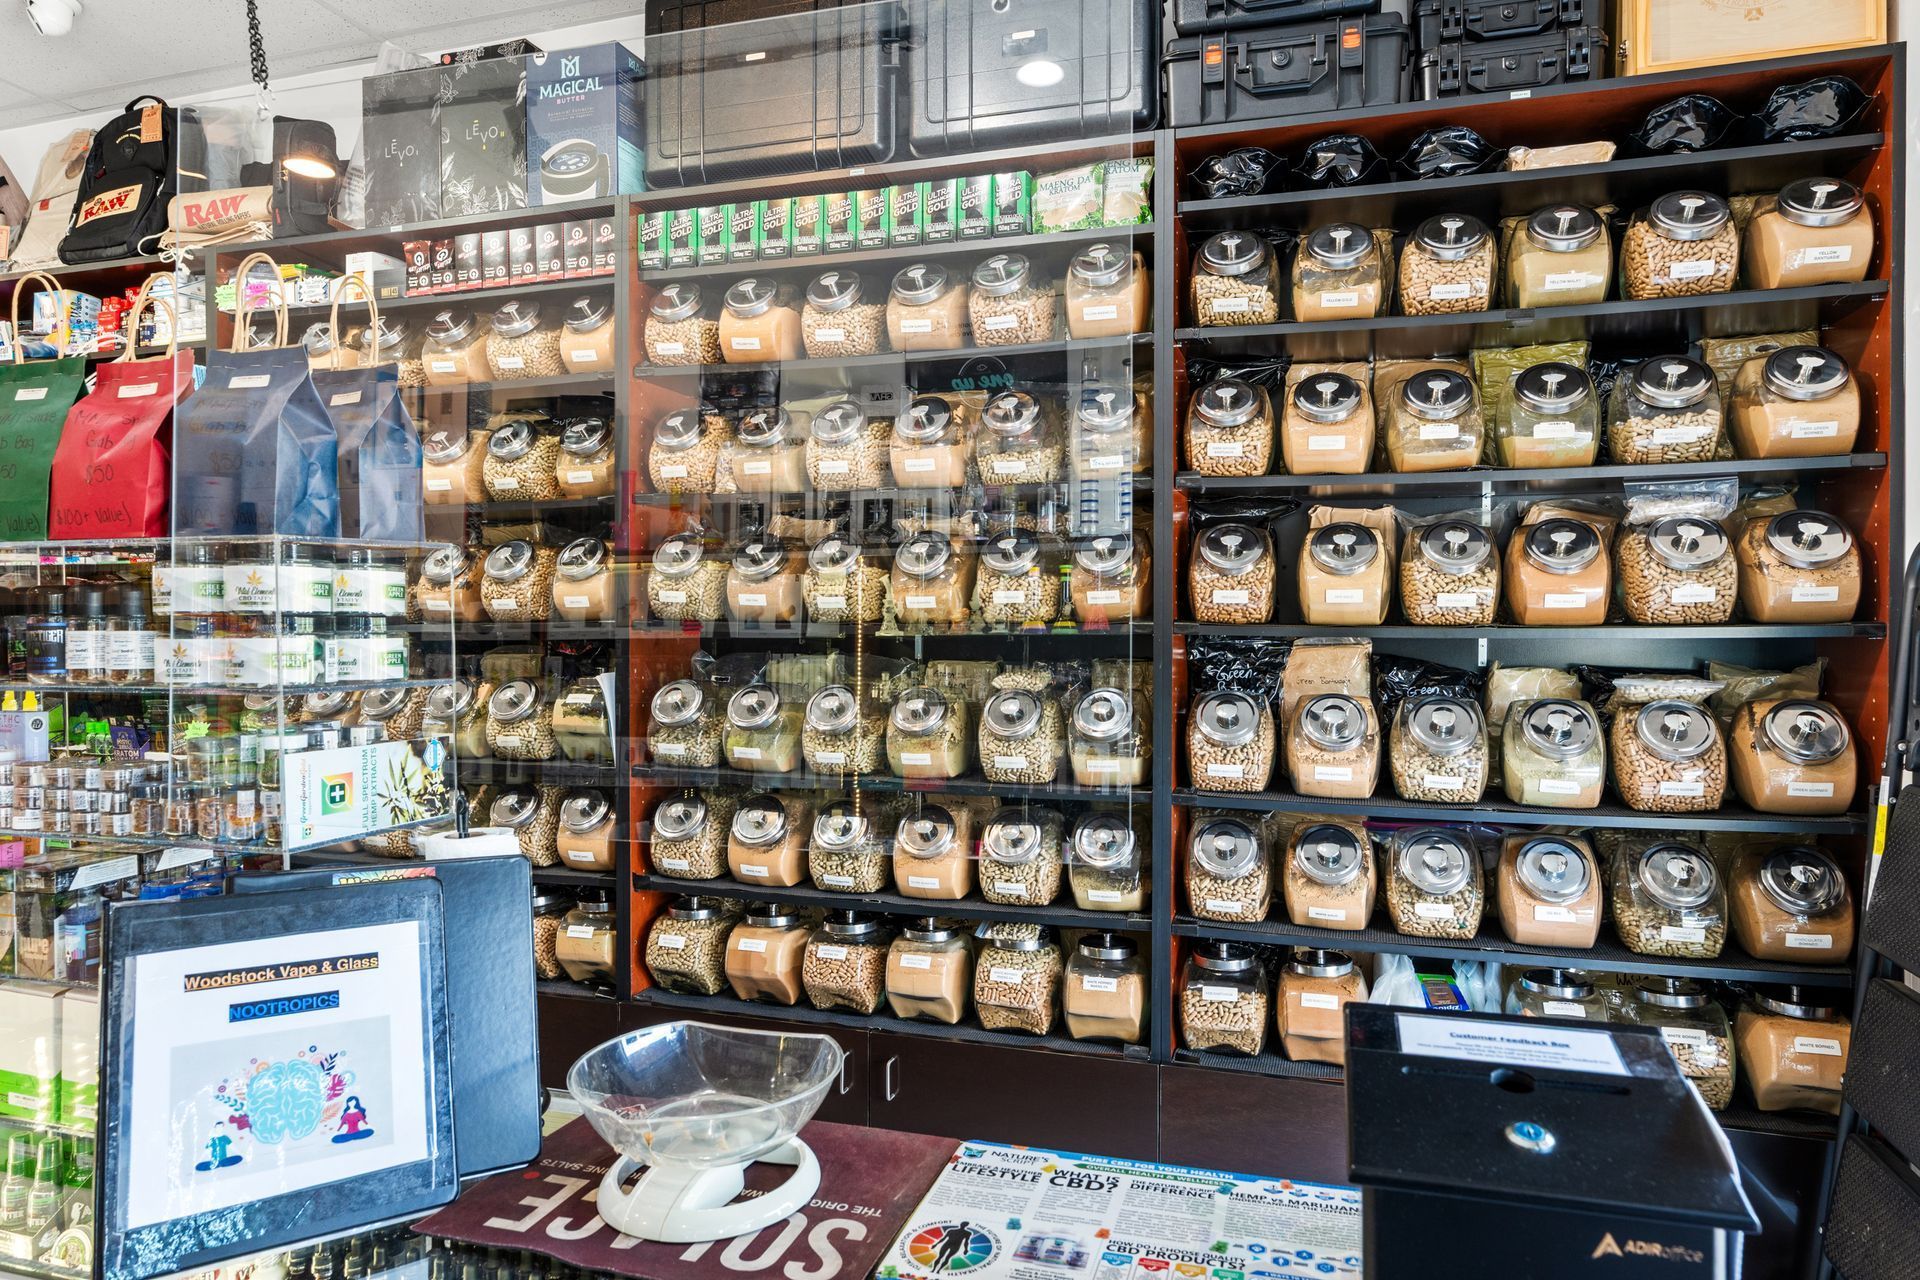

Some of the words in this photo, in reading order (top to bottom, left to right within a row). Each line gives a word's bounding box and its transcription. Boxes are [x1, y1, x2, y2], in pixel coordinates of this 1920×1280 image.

[539, 76, 604, 100] MAGICAL
[556, 94, 586, 105] BUTTER
[1136, 158, 1152, 166] DA
[1040, 178, 1074, 192] MAENG
[1077, 175, 1091, 185] DA
[1049, 184, 1080, 196] KRATOM
[860, 195, 884, 209] ULTRA
[894, 190, 918, 205] ULTRA
[83, 192, 132, 221] RAW
[184, 194, 249, 227] RAW
[763, 205, 786, 219] ULTRA
[796, 201, 818, 215] ULTRA
[828, 199, 850, 213] ULTRA
[894, 202, 918, 217] GOLD
[234, 212, 251, 222] PAPERS
[670, 214, 692, 227] ULTRA
[701, 211, 723, 226] ULTRA
[732, 208, 754, 222] ULTRA
[796, 213, 819, 228] GOLD
[828, 210, 851, 224] GOLD
[860, 207, 885, 222] GOLD
[641, 216, 662, 230] ULTRA
[701, 223, 723, 238] GOLD
[732, 219, 755, 234] GOLD
[764, 216, 787, 231] GOLD
[641, 228, 663, 243] GOLD
[670, 226, 692, 240] GOLD
[85, 465, 114, 485] $50
[1407, 686, 1440, 697] Green
[184, 966, 275, 992] Woodstock
[280, 961, 316, 980] Vape
[322, 960, 332, 973] &
[336, 953, 378, 970] Glass
[229, 992, 340, 1020] NOOTROPICS
[1450, 1032, 1497, 1042] Customer
[1500, 1036, 1546, 1047] Feedback
[1550, 1040, 1570, 1048] Box
[992, 1150, 1050, 1163] NATURE'S
[1002, 1158, 1035, 1166] SCRIPT
[540, 1158, 584, 1171] SALTS
[1081, 1156, 1108, 1165] PURE
[1111, 1160, 1132, 1168] CBD
[1135, 1163, 1156, 1171] FOR
[1159, 1166, 1187, 1174] YOUR
[1191, 1169, 1234, 1180] HEALTH
[952, 1164, 1040, 1183] LIFESTYLE
[1054, 1169, 1102, 1180] WHAT
[1086, 1164, 1125, 1174] OVERALL
[1128, 1169, 1163, 1178] HEALTH
[1177, 1176, 1225, 1186] WELLNESS
[1049, 1176, 1118, 1193] CBD?
[1130, 1184, 1215, 1200] DIFFERENCE
[1229, 1197, 1300, 1209] UNDERSTANDING
[1321, 1208, 1360, 1216] DIFFEREN
[1230, 1192, 1267, 1201] HEMP
[1288, 1200, 1360, 1212] MARIJUAN
[850, 1205, 882, 1217] THE
[918, 1220, 953, 1230] COMFORT
[1106, 1244, 1140, 1255] CBD
[1146, 1250, 1246, 1271] PRODUCTS?
[1159, 1247, 1200, 1257] CHOOSE
[1203, 1252, 1246, 1263] QUALITY
